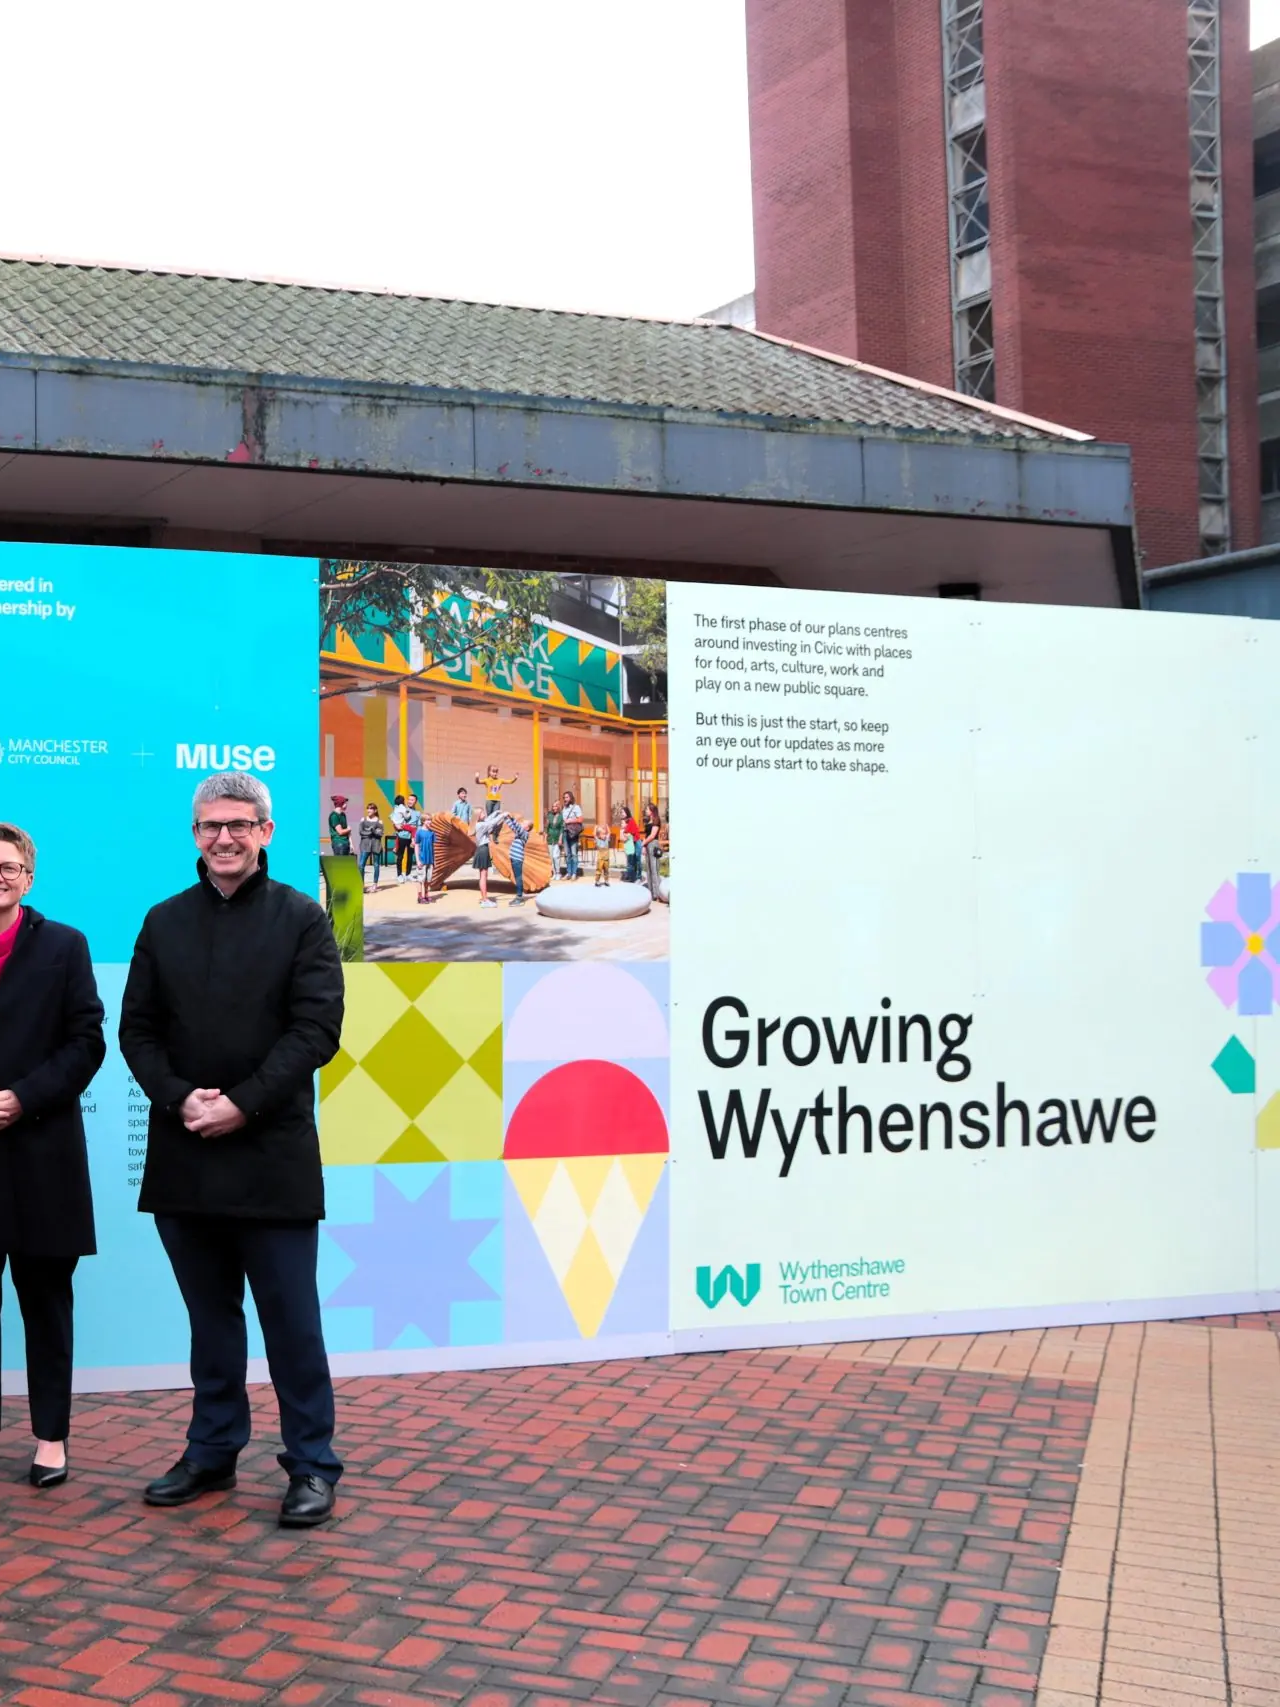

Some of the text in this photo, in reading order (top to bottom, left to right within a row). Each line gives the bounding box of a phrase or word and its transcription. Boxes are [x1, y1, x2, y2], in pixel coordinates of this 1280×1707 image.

[38, 578, 53, 592] in
[56, 601, 76, 620] by
[693, 613, 908, 639] The first phase of our plans centres
[694, 636, 912, 661] around investing in Civic with places
[695, 655, 884, 678] for food, arts, culture, work and
[695, 676, 868, 699] play on a new public square.
[696, 712, 889, 736] But this is just the start, so keep
[9, 739, 108, 753] MANCHESTER
[696, 735, 885, 753] an eye out for updates as more
[8, 754, 80, 765] CITY COUNCIL
[696, 754, 888, 776] of our plans start to take shape.
[702, 996, 973, 1082] Growing
[128, 1088, 141, 1097] As
[697, 1080, 1156, 1178] Wythenshawe
[779, 1256, 905, 1284] Wythenshawe
[778, 1280, 890, 1304] Town Centre
